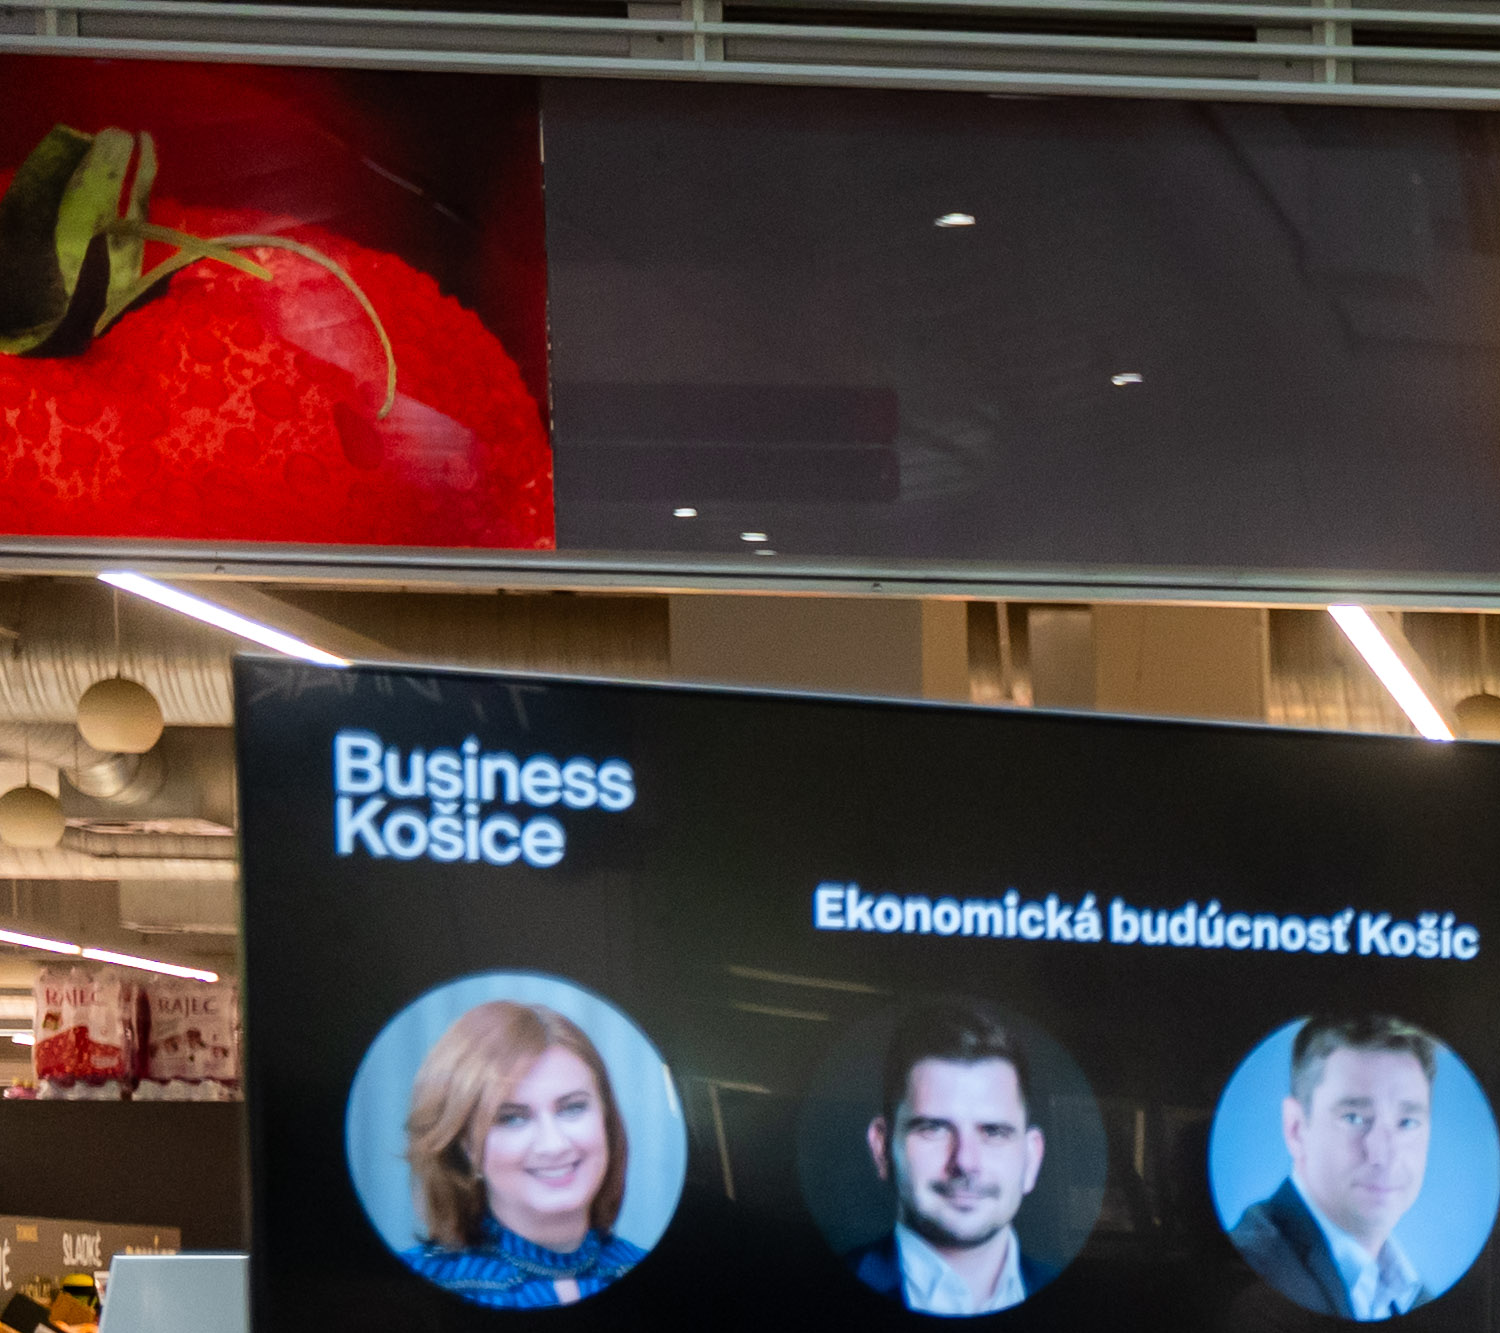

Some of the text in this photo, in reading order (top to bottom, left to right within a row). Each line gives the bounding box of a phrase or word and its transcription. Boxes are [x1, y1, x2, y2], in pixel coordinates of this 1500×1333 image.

[333, 728, 636, 812] Business
[334, 798, 567, 868] Košice
[814, 883, 1480, 960] Ekonomická budúcnosť Košíc
